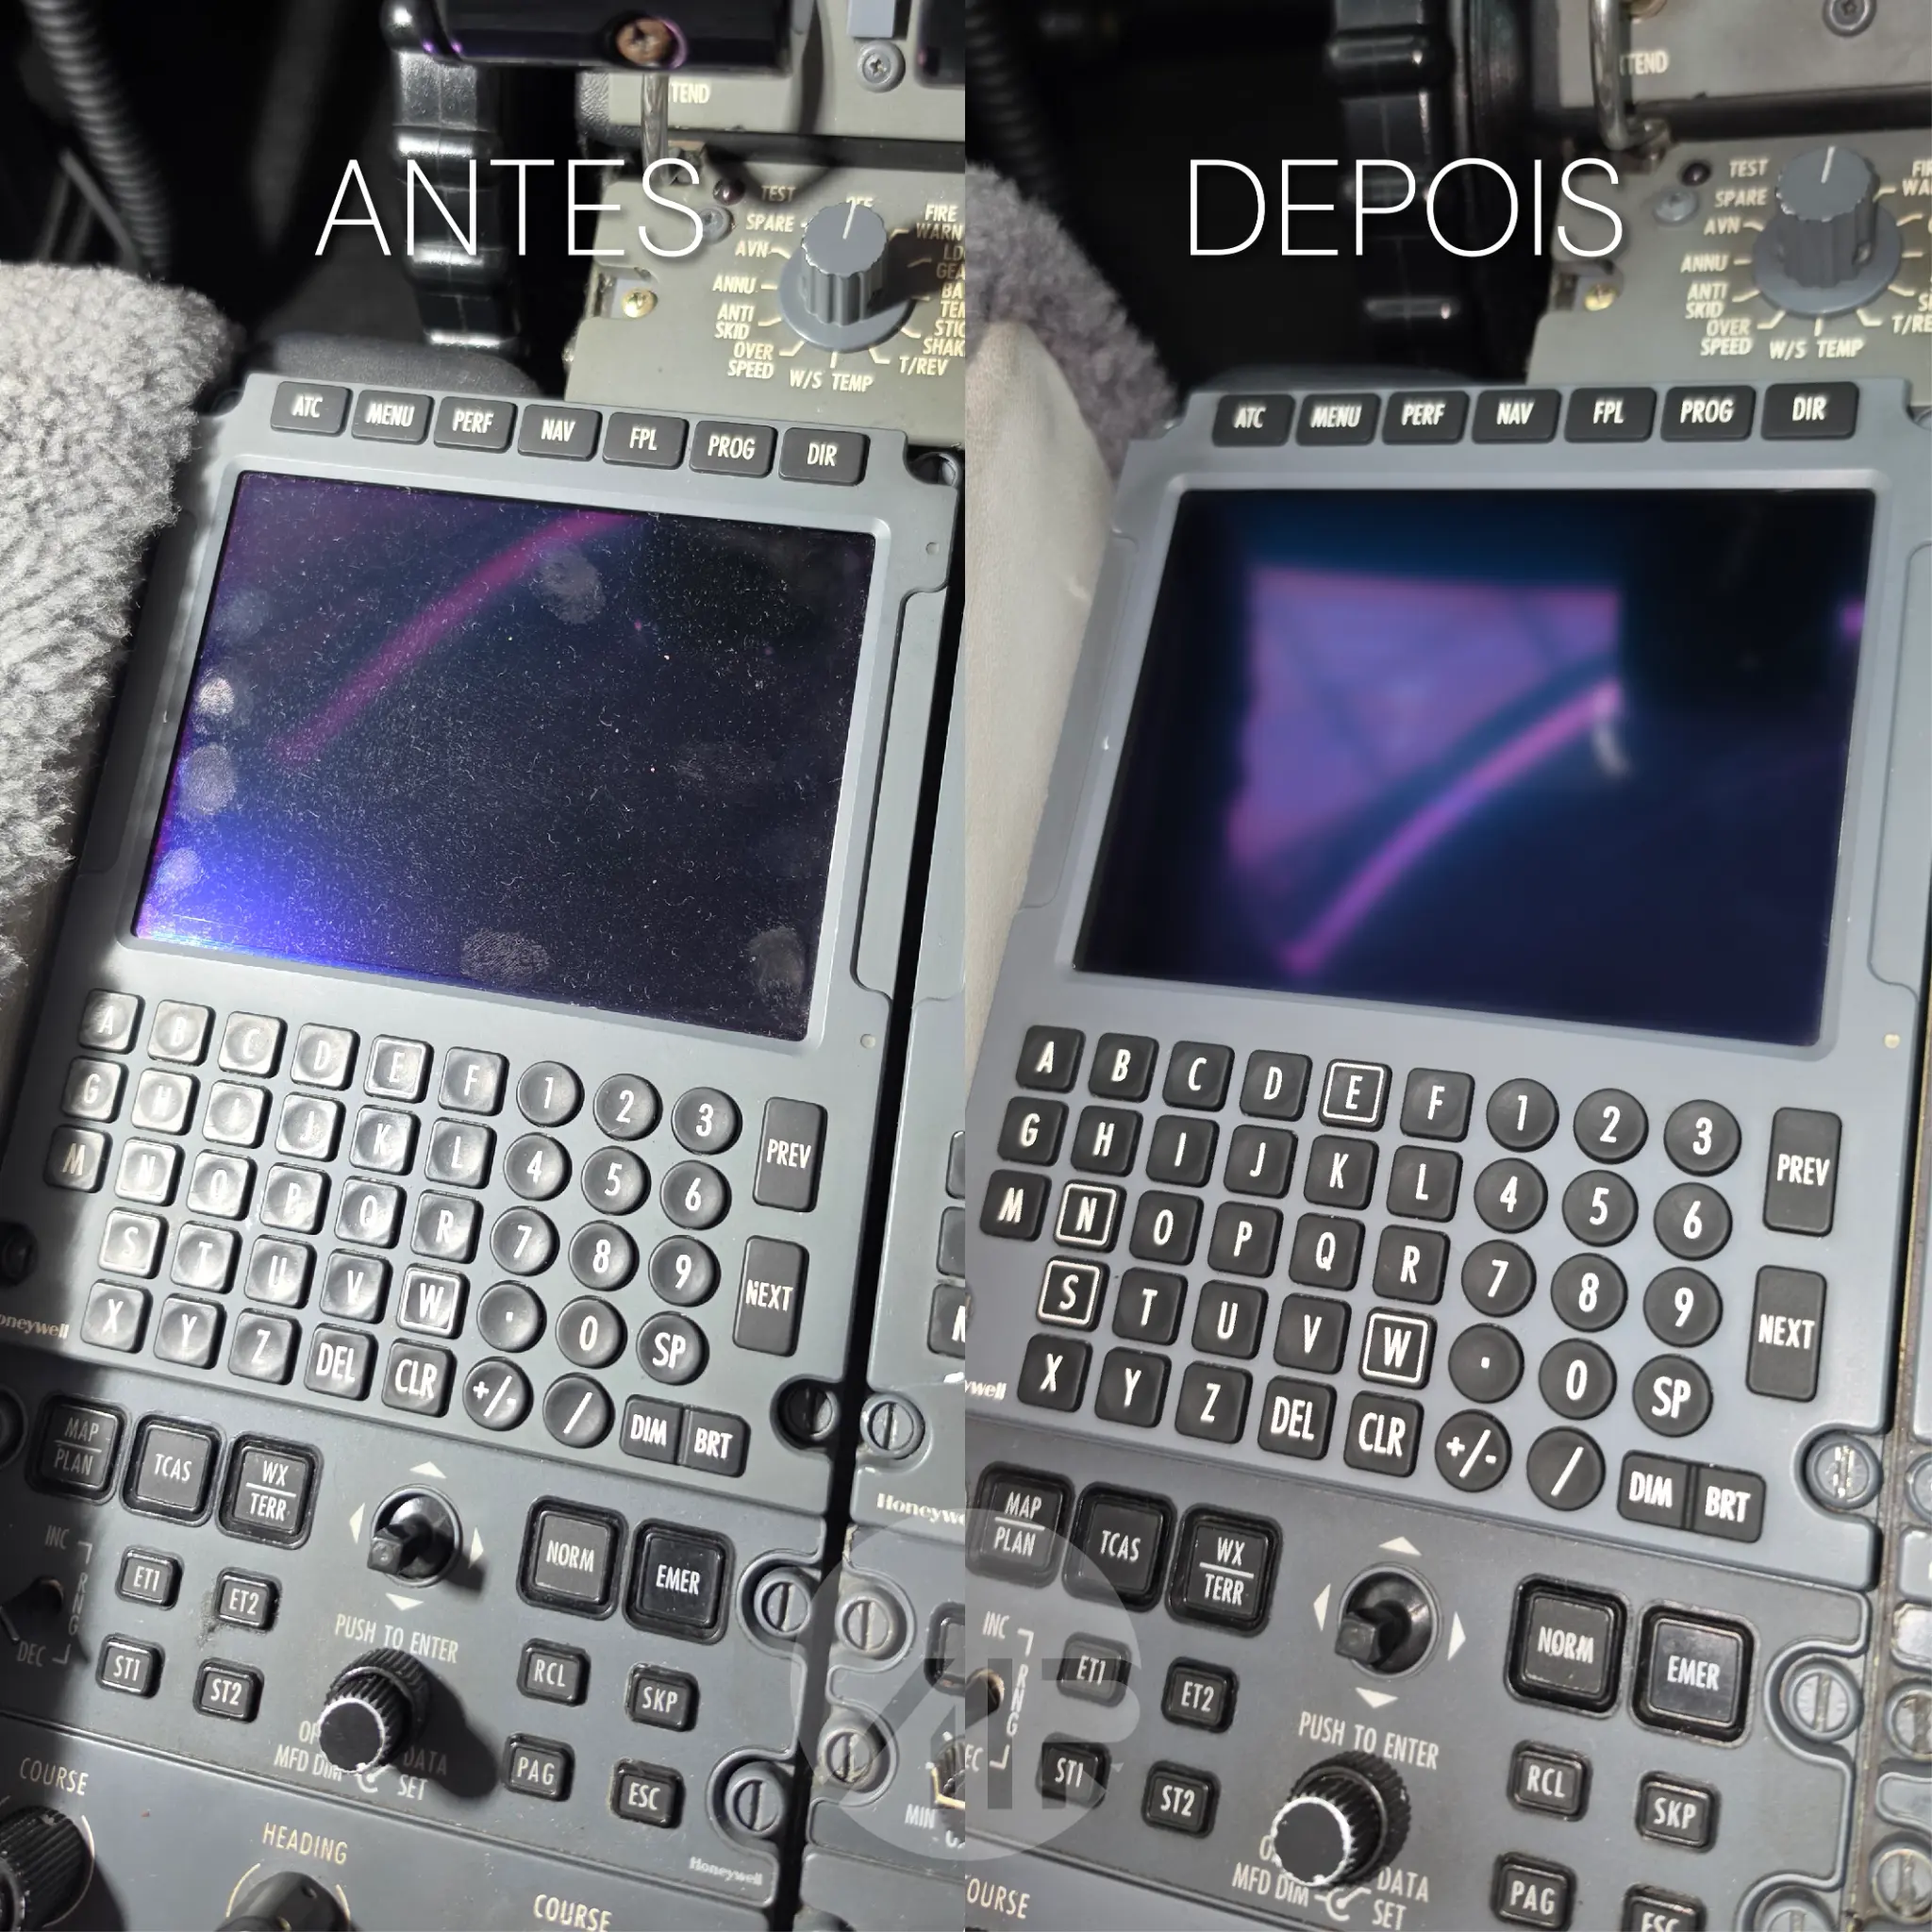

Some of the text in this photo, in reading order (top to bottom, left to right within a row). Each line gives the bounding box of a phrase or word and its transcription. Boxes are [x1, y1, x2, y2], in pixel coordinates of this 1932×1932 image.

[1728, 158, 1770, 178] TEST
[760, 185, 796, 202] TEST
[1714, 189, 1769, 208] SPARE
[745, 214, 795, 233] SPARE
[924, 203, 959, 223] FIRE
[1704, 216, 1742, 236] AVN
[916, 223, 965, 242] WARN
[735, 240, 771, 259] AVN
[1680, 254, 1731, 274] ANNU
[712, 275, 757, 295] ANNU
[1686, 282, 1729, 302] ANTI
[717, 303, 756, 323] ANTI
[1685, 301, 1724, 320] SKID
[714, 322, 751, 341] SKID
[1706, 318, 1753, 337] OVER
[733, 341, 774, 361] OVER
[1700, 337, 1754, 357] SPEED
[1769, 339, 1866, 361] W/S TEMP
[726, 360, 774, 380] SPEED
[789, 369, 874, 393] W/S TEMP
[899, 356, 950, 376] T/REV
[291, 395, 324, 419] ATC
[364, 401, 416, 428] MENU
[452, 410, 493, 434] PERF
[1233, 405, 1267, 430] ATC
[1310, 403, 1362, 428] MENU
[1401, 402, 1445, 426] PERF
[1496, 400, 1535, 425] NAV
[1592, 399, 1625, 424] FPL
[1679, 397, 1735, 424] PROG
[1792, 394, 1828, 421] DIR
[541, 418, 576, 441] NAV
[628, 427, 658, 451] FPL
[707, 434, 756, 461] PROG
[806, 441, 840, 467] DIR
[1037, 1041, 1055, 1074] A
[1112, 1049, 1131, 1082] B
[1189, 1057, 1207, 1091] C
[1263, 1066, 1283, 1101] D
[544, 1076, 554, 1108] 1
[616, 1090, 634, 1123] 2
[1345, 1075, 1362, 1110] E
[1428, 1086, 1446, 1120] F
[695, 1104, 713, 1136] 3
[1517, 1095, 1527, 1130] 1
[1600, 1107, 1621, 1142] 2
[1021, 1112, 1040, 1147] G
[1093, 1122, 1115, 1157] H
[1692, 1117, 1712, 1155] 3
[62, 1141, 86, 1176] M
[526, 1150, 542, 1182] 4
[766, 1139, 811, 1169] PREV
[1250, 1142, 1266, 1177] J
[1777, 1154, 1830, 1186] PREV
[605, 1163, 621, 1196] 5
[1329, 1153, 1349, 1189] K
[1416, 1164, 1429, 1200] L
[685, 1177, 702, 1211] 6
[997, 1187, 1024, 1224] M
[1500, 1176, 1517, 1212] 4
[1589, 1188, 1608, 1224] 5
[1075, 1197, 1095, 1233] N
[1683, 1201, 1702, 1239] 6
[514, 1225, 532, 1259] 7
[1234, 1221, 1253, 1257] P
[1316, 1232, 1336, 1272] Q
[592, 1239, 611, 1274] 8
[675, 1254, 693, 1290] 9
[1400, 1244, 1420, 1284] R
[1059, 1274, 1079, 1309] S
[1488, 1259, 1508, 1297] 7
[1578, 1273, 1598, 1312] 8
[418, 1282, 445, 1319] W
[745, 1281, 793, 1311] NEXT
[1141, 1290, 1158, 1326] T
[1674, 1288, 1694, 1327] 9
[181, 1313, 199, 1348] Y
[1218, 1301, 1238, 1340] U
[1304, 1314, 1322, 1354] V
[1759, 1315, 1815, 1349] NEXT
[252, 1328, 271, 1365] Z
[316, 1341, 356, 1382] DEL
[653, 1332, 686, 1369] SP
[1383, 1328, 1412, 1368] W
[394, 1357, 438, 1399] CLR
[1040, 1353, 1062, 1392] X
[1124, 1369, 1141, 1407] Y
[1200, 1383, 1221, 1423] Z
[1652, 1378, 1691, 1419] SP
[64, 1420, 99, 1441] MAP
[630, 1414, 667, 1446] DIM
[1271, 1395, 1314, 1441] DEL
[693, 1427, 733, 1459] BRT
[1358, 1412, 1406, 1457] CLR
[54, 1448, 93, 1475] PLAN
[154, 1453, 192, 1482] TCAS
[261, 1459, 289, 1487] WX
[1006, 1492, 1041, 1519] MAP
[1629, 1473, 1673, 1507] DIM
[249, 1492, 288, 1522] TERR
[1706, 1491, 1751, 1523] BRT
[45, 1524, 69, 1549] INC
[994, 1527, 1034, 1557] PLAN
[1101, 1530, 1141, 1562] TCAS
[1216, 1537, 1246, 1565] WX
[546, 1540, 594, 1574] NORM
[133, 1566, 159, 1592] ET1
[656, 1564, 702, 1596] EMER
[1205, 1574, 1244, 1606] TERR
[228, 1588, 259, 1615] ET2
[336, 1612, 459, 1664] PUSH TO ENTER
[983, 1612, 1009, 1640] INC
[1538, 1626, 1594, 1663] NORM
[113, 1655, 142, 1681] ST1
[534, 1659, 566, 1689] RCL
[1076, 1657, 1106, 1685] ET1
[1667, 1656, 1720, 1690] EMER
[210, 1676, 242, 1706] ST2
[641, 1686, 678, 1714] SKP
[1181, 1681, 1215, 1711] ET2
[1299, 1712, 1440, 1769] PUSH TO ENTER
[274, 1743, 309, 1772] MFD
[517, 1756, 557, 1786] PAG
[1055, 1758, 1083, 1788] ST1
[19, 1757, 90, 1796] COURSE
[397, 1774, 428, 1801] SET
[1526, 1765, 1566, 1798] RCL
[627, 1783, 659, 1811] ESC
[1160, 1786, 1195, 1817] ST2
[1653, 1796, 1696, 1830] SKP
[261, 1822, 349, 1866] HEADING
[689, 1856, 763, 1887] Honeywell
[1232, 1862, 1309, 1907] MFD DIM
[1378, 1866, 1430, 1903] DATA
[533, 1891, 613, 1932] COURSE
[1510, 1881, 1556, 1914] PAG
[1373, 1899, 1407, 1930] SET
